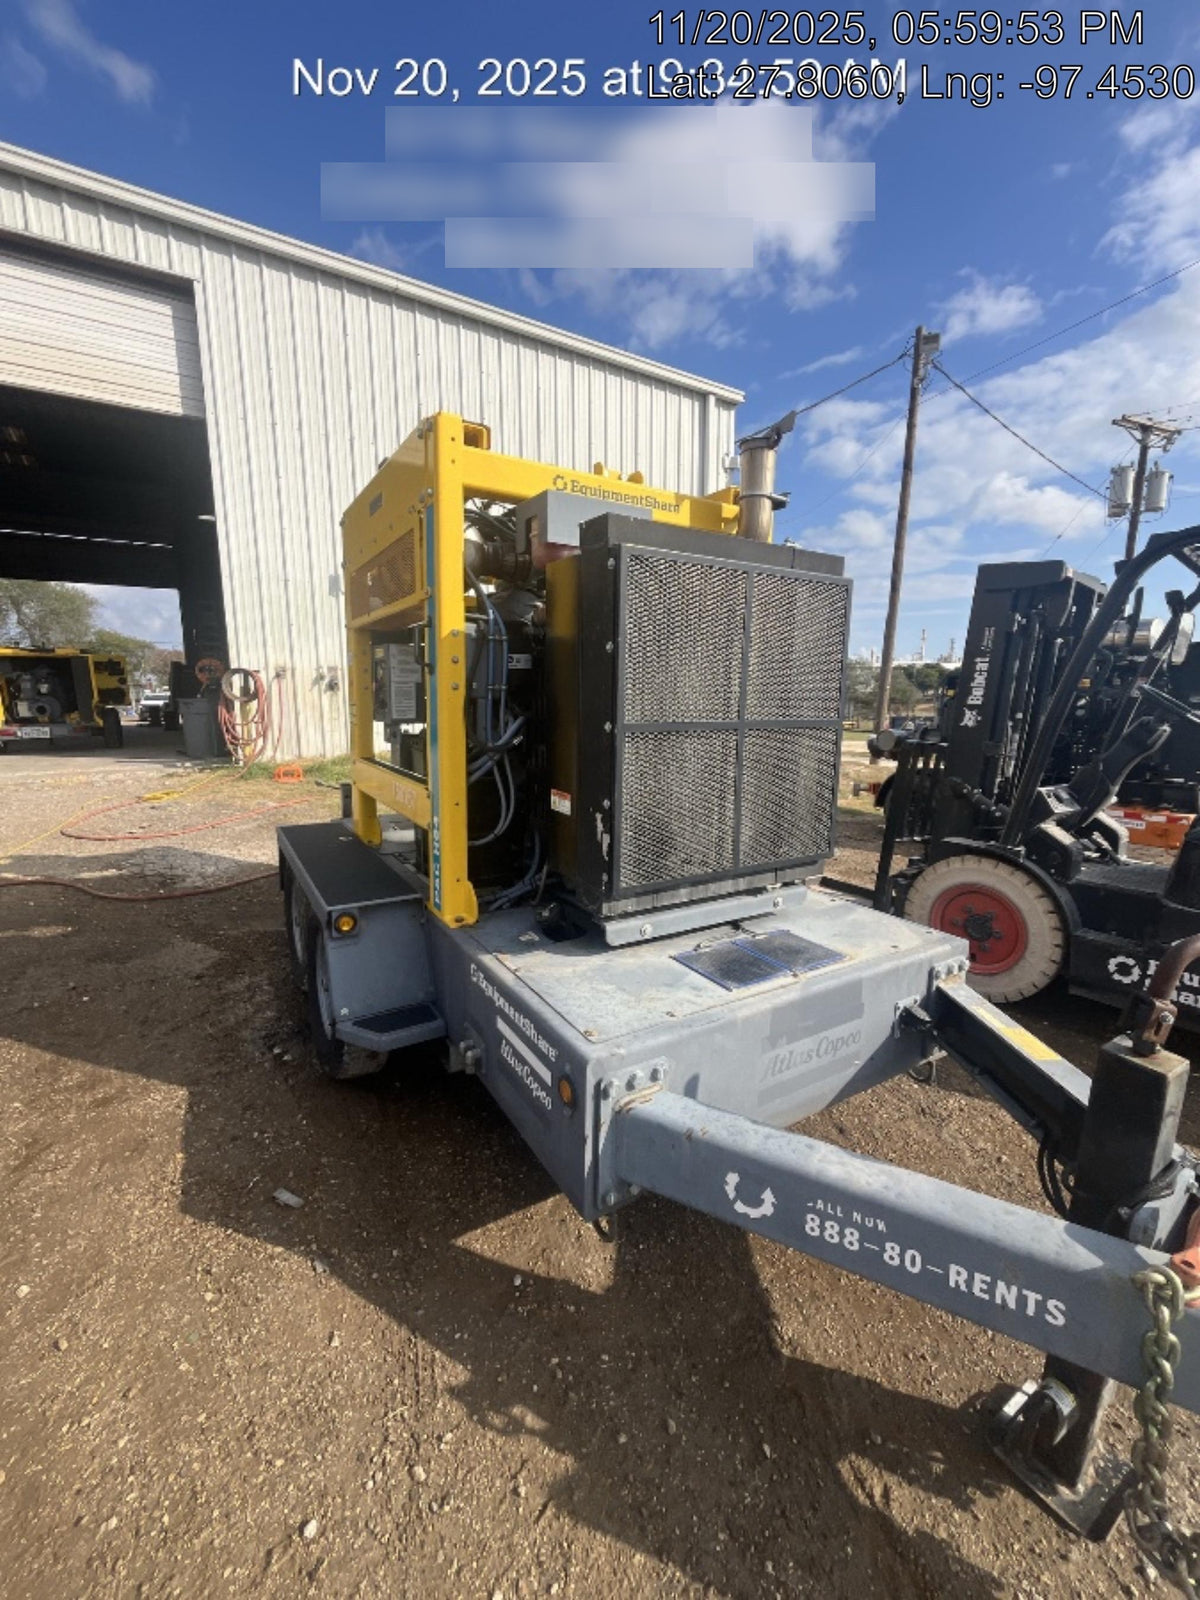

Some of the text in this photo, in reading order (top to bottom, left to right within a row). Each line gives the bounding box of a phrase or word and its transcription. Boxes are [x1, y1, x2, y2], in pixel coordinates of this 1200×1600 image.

[966, 656, 991, 705] Bobcat
[806, 1198, 844, 1218] ALL
[804, 1212, 1067, 1328] 888-80-RENTS
